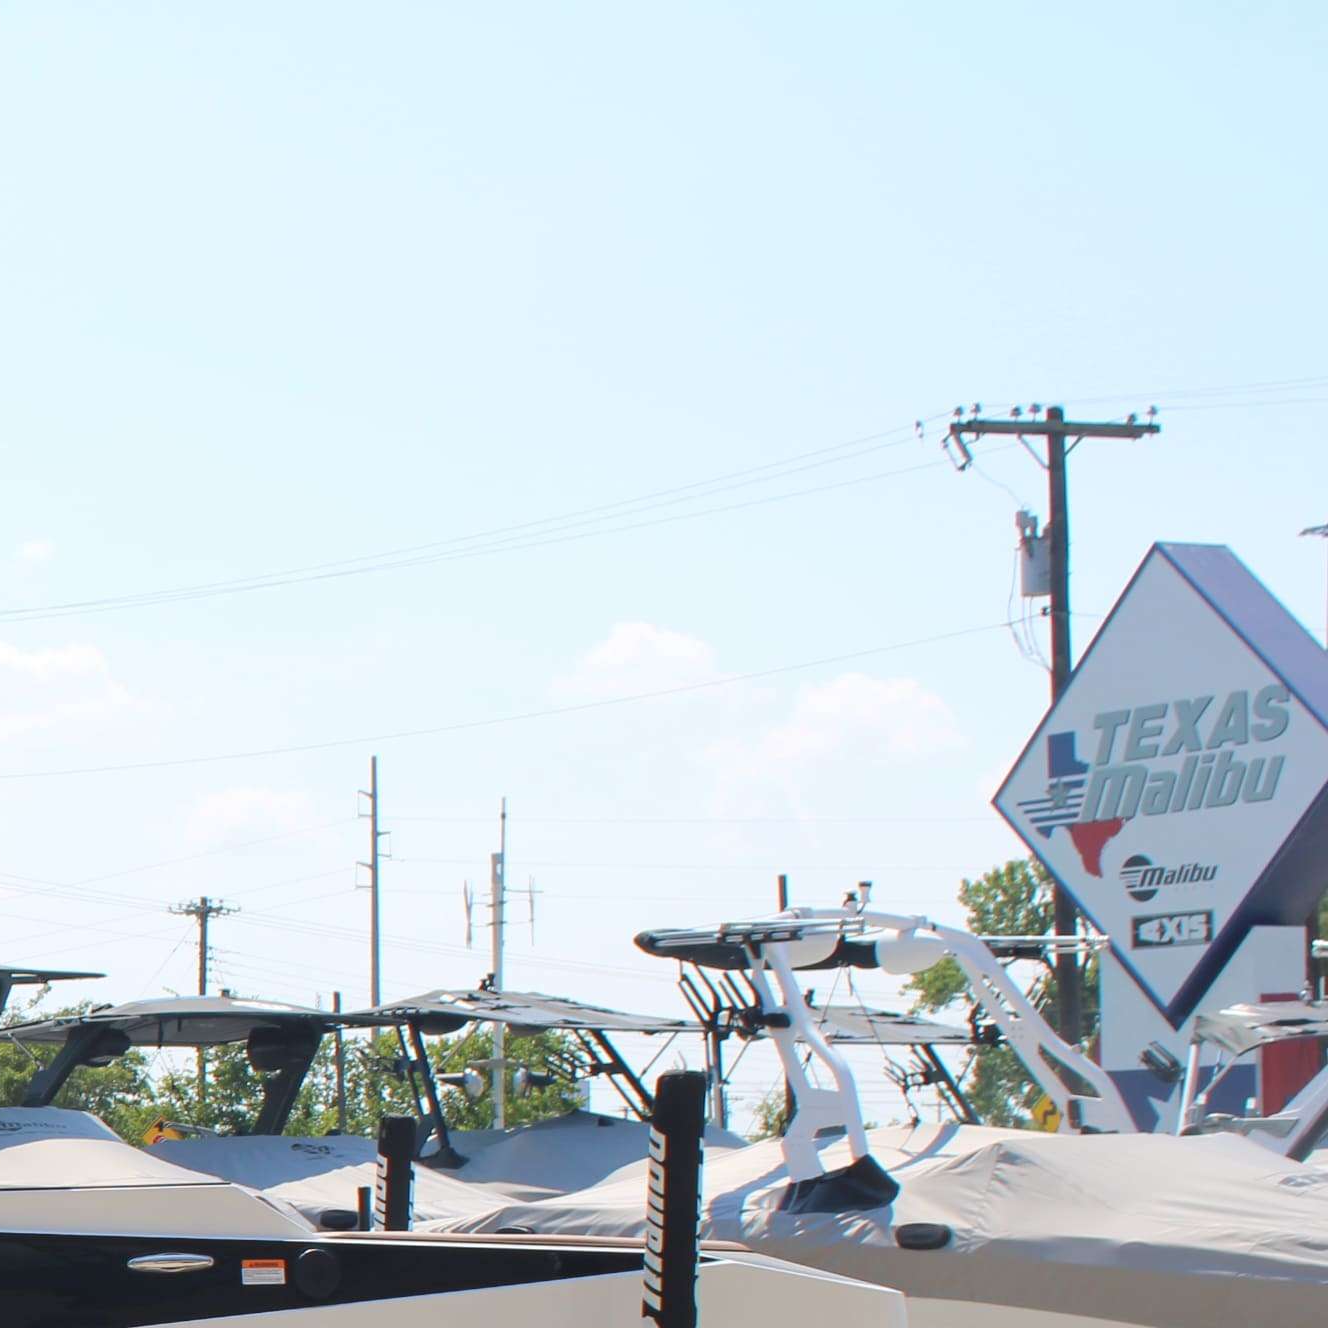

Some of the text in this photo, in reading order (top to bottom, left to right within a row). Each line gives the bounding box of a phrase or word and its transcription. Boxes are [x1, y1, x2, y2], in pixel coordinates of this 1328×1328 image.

[1093, 684, 1291, 767] TEXAS
[1078, 751, 1286, 823] Malibu
[1138, 862, 1218, 888] Malibu
